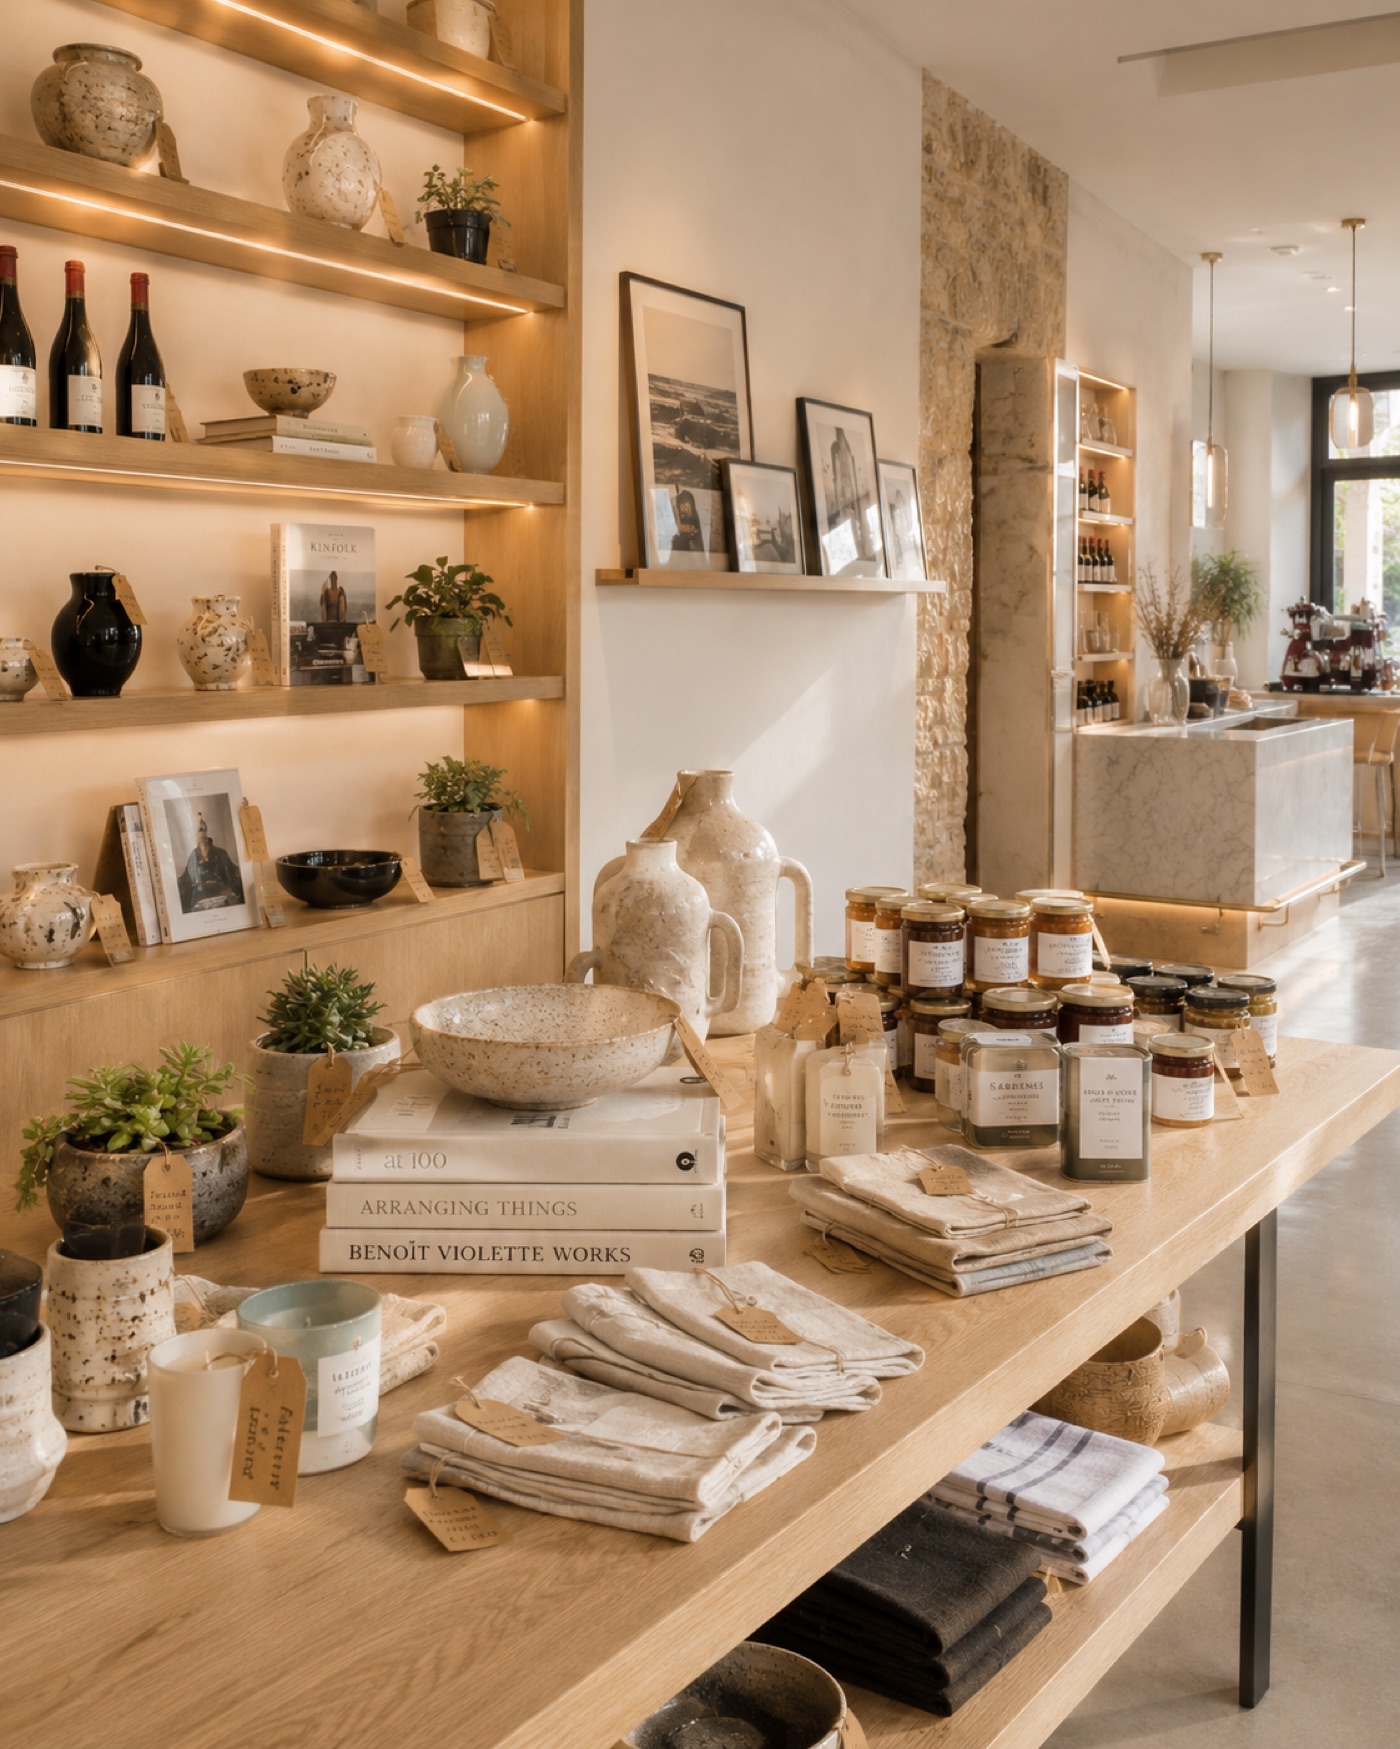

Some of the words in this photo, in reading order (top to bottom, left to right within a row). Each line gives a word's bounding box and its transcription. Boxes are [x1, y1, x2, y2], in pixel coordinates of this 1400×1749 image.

[384, 1154, 402, 1169] at
[411, 1152, 447, 1169] 100
[360, 1199, 489, 1216] ARRANGING
[496, 1200, 578, 1216] THINGS
[437, 1245, 544, 1262] VIOLETTE
[552, 1246, 631, 1262] WORKS
